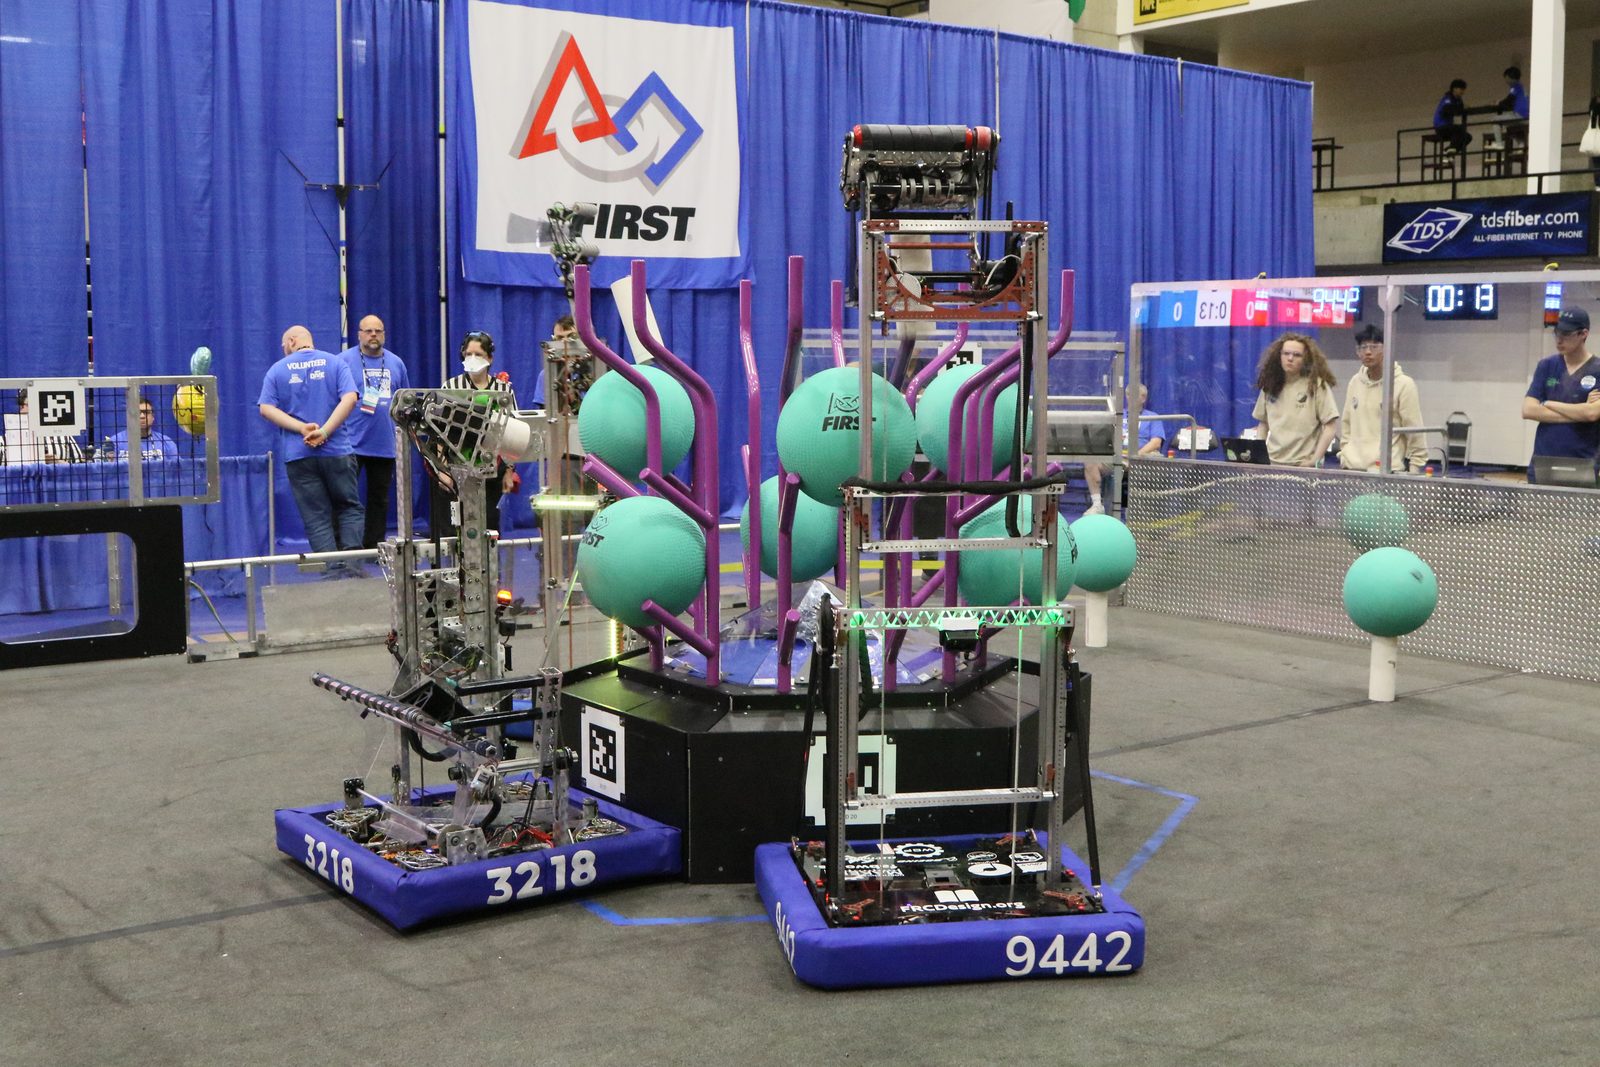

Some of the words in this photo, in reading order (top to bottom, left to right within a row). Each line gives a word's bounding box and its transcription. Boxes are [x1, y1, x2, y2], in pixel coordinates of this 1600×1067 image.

[571, 203, 696, 241] FIRST
[1411, 221, 1447, 240] TDS
[1480, 210, 1579, 228] tdsfiber.com
[1506, 231, 1539, 242] INTERNET
[1543, 231, 1553, 240] TV
[1557, 230, 1583, 239] PHONE
[1312, 287, 1360, 313] 9442
[1427, 284, 1494, 312] 00:13
[287, 359, 327, 370] VOLUNTEER
[822, 415, 877, 431] FIRS
[304, 833, 354, 895] 3218
[486, 849, 597, 905] 3218
[900, 901, 1026, 913] FRCDesign.org
[775, 901, 797, 976] 9442
[1005, 930, 1133, 977] 9442
